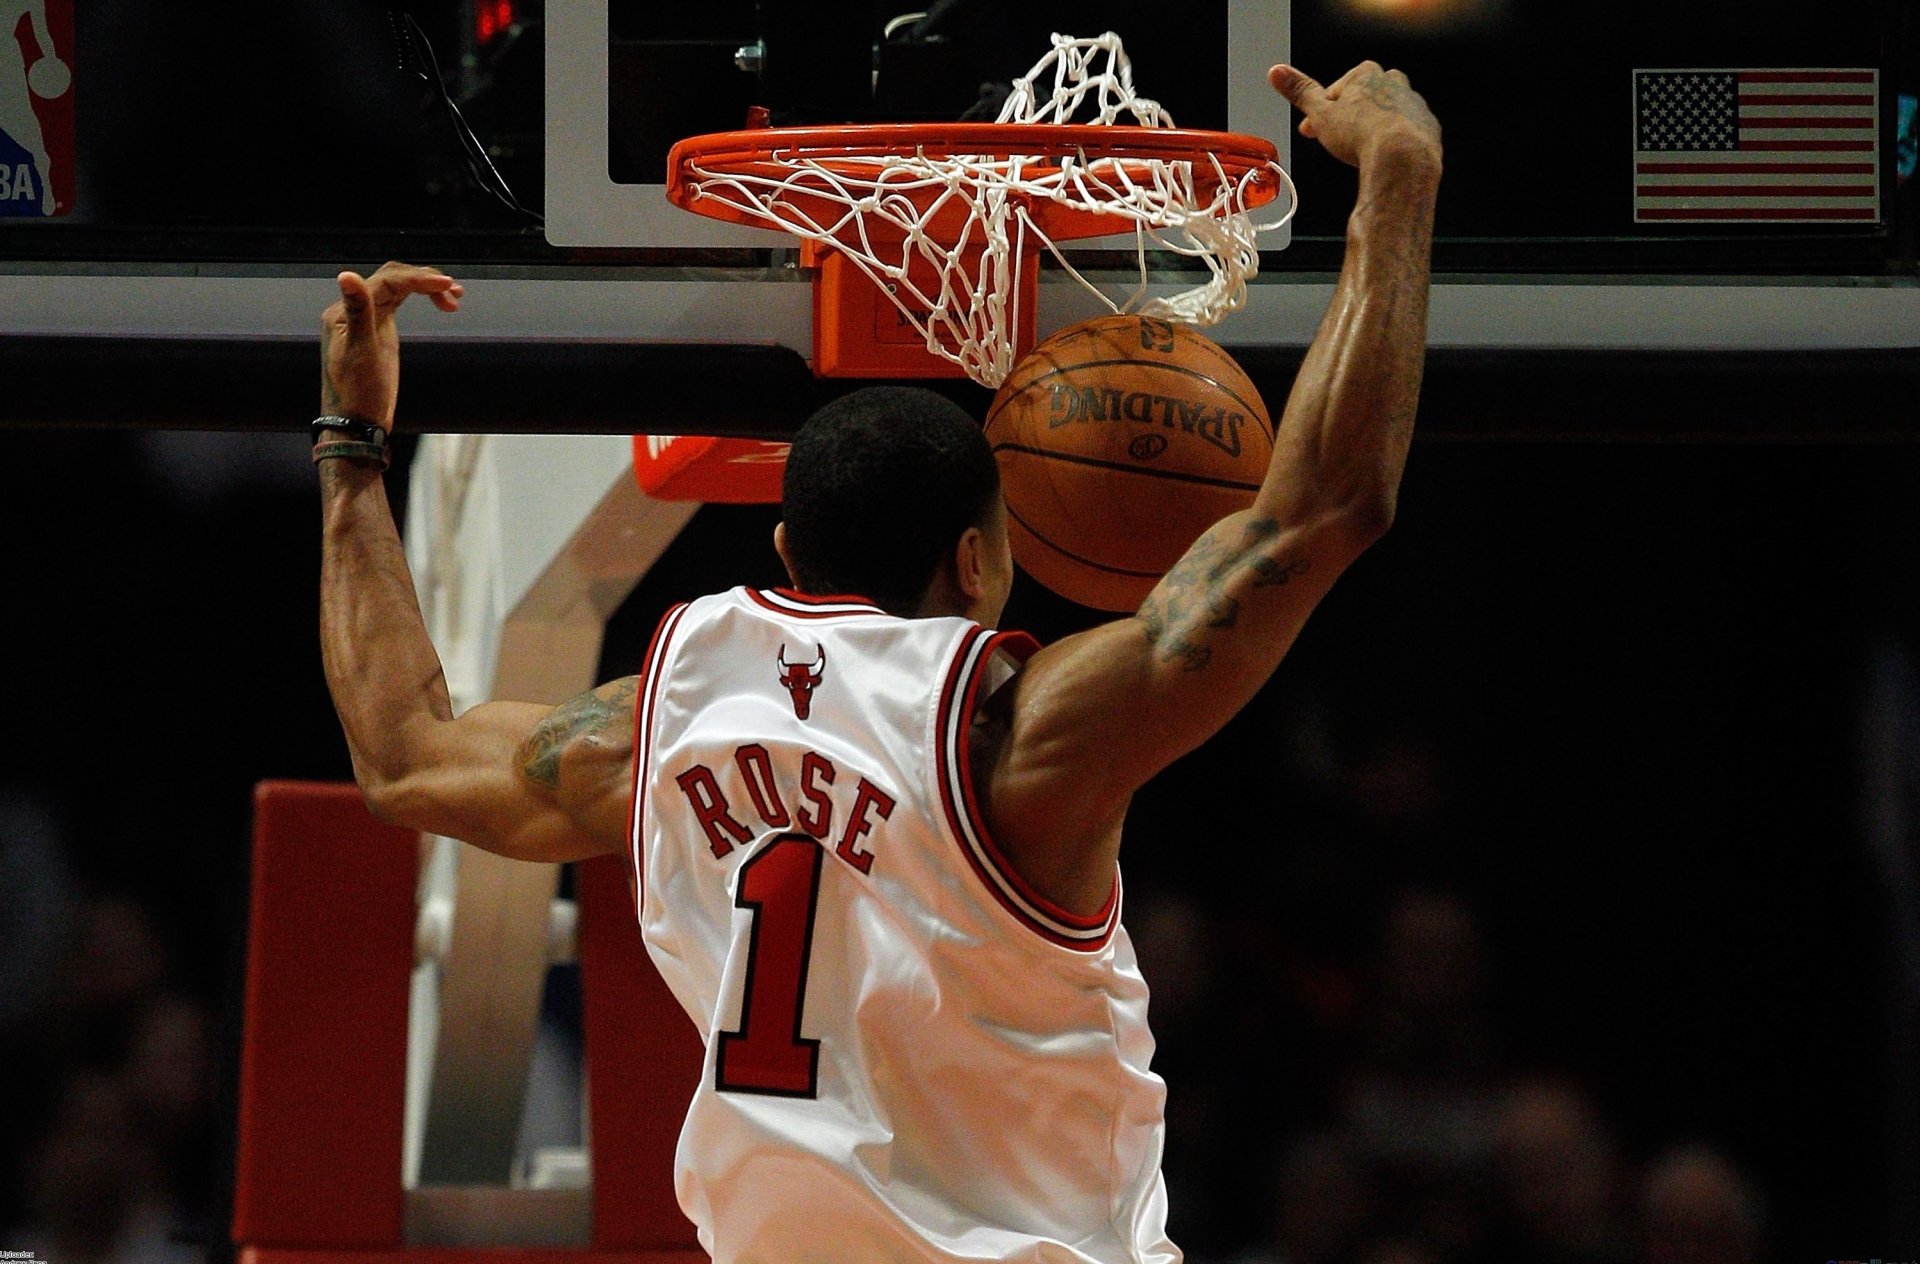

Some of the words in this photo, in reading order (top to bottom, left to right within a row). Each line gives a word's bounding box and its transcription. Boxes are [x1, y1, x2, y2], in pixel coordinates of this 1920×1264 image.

[1049, 382, 1245, 458] SPALDING
[676, 743, 896, 876] ROSE
[715, 833, 823, 1099] 1
